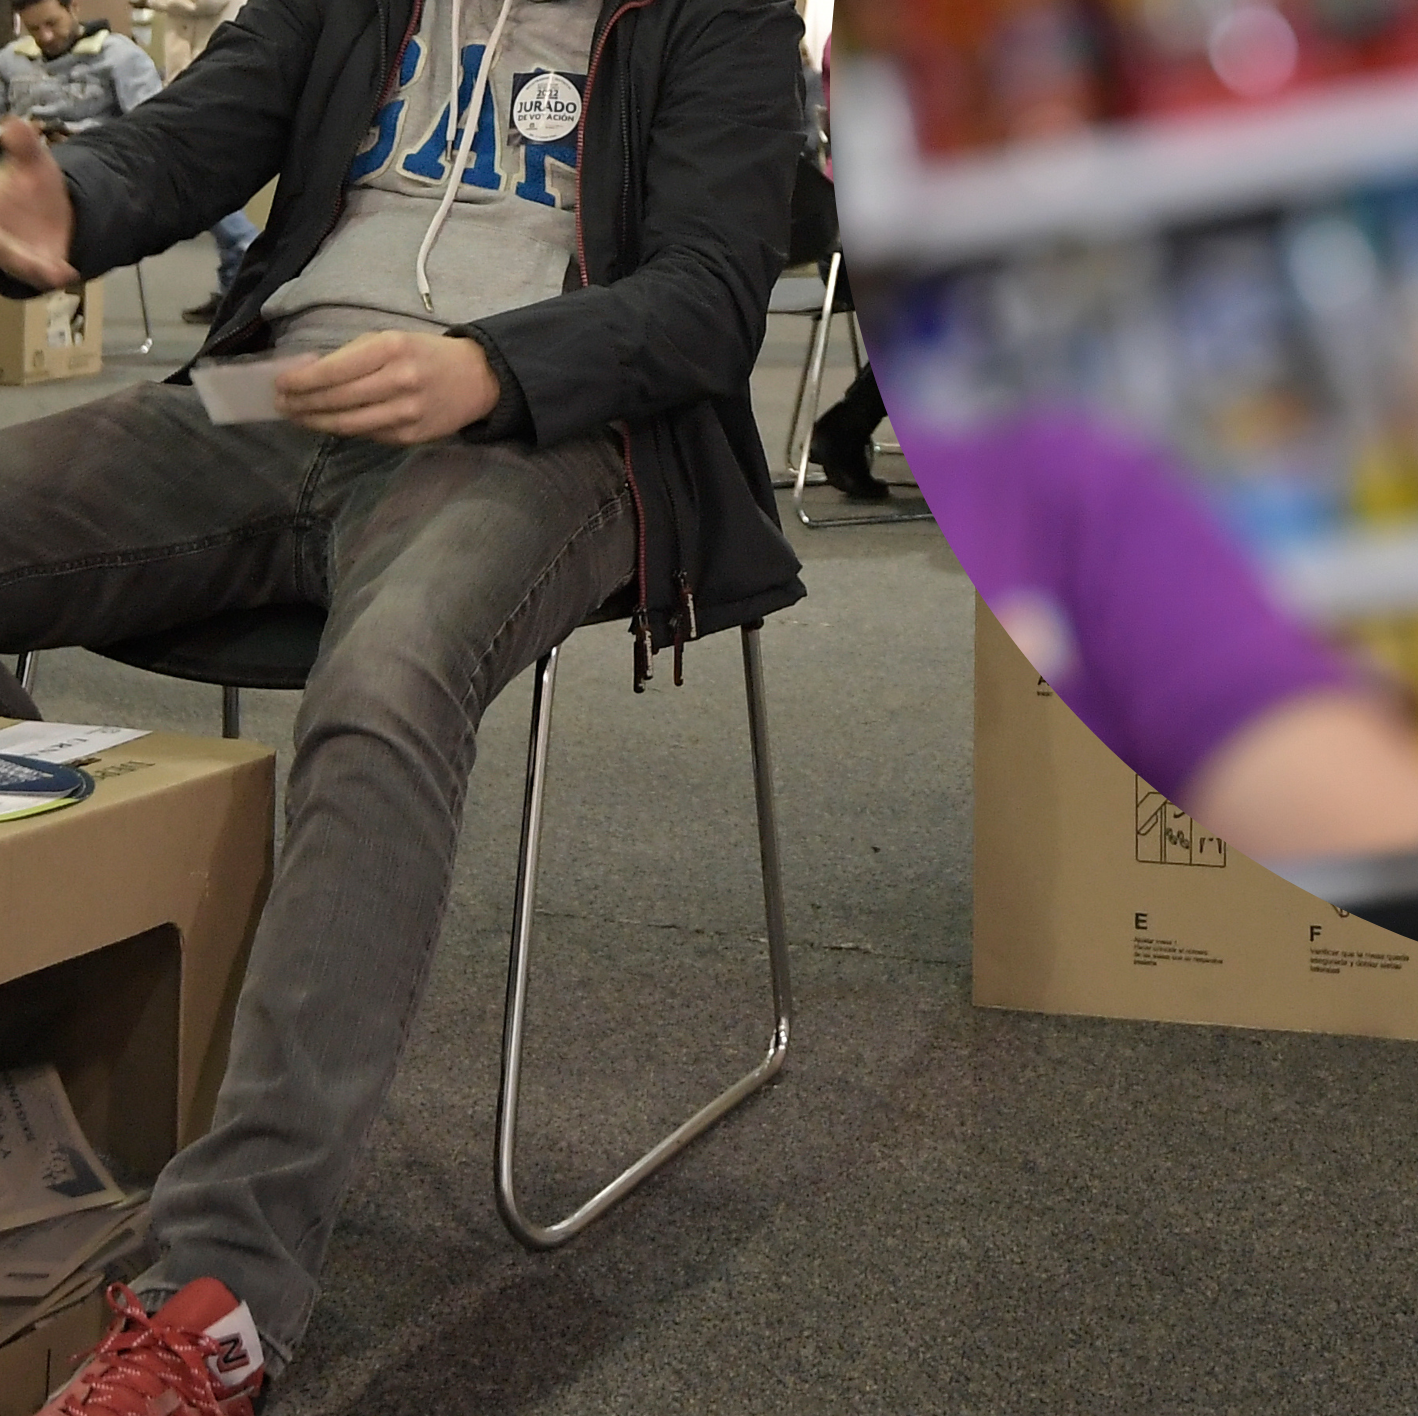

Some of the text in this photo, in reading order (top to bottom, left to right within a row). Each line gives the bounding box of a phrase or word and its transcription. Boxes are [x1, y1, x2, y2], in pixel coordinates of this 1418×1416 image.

[517, 100, 578, 114] JURADO
[518, 114, 528, 122] DE
[1134, 912, 1148, 930] E
[1309, 925, 1322, 942] F
